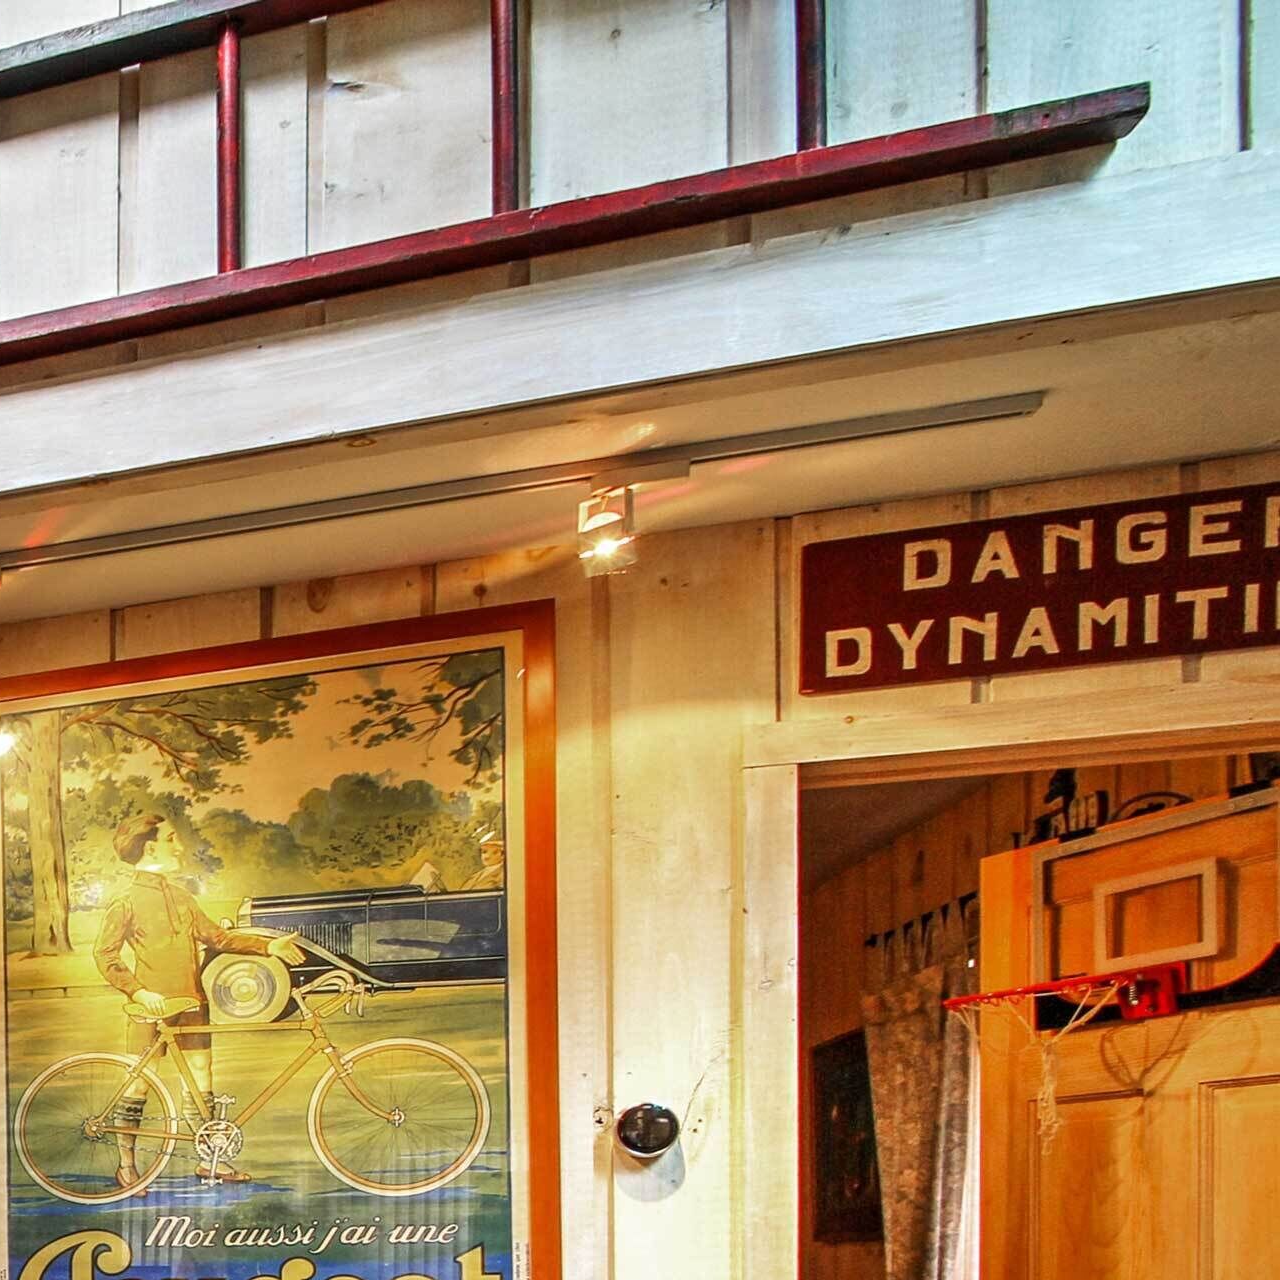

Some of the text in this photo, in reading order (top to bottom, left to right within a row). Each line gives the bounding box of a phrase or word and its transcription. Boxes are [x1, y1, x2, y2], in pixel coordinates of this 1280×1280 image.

[825, 579, 1280, 679] DYNAMITI
[144, 1214, 459, 1255] Moi aussi j'ai une
